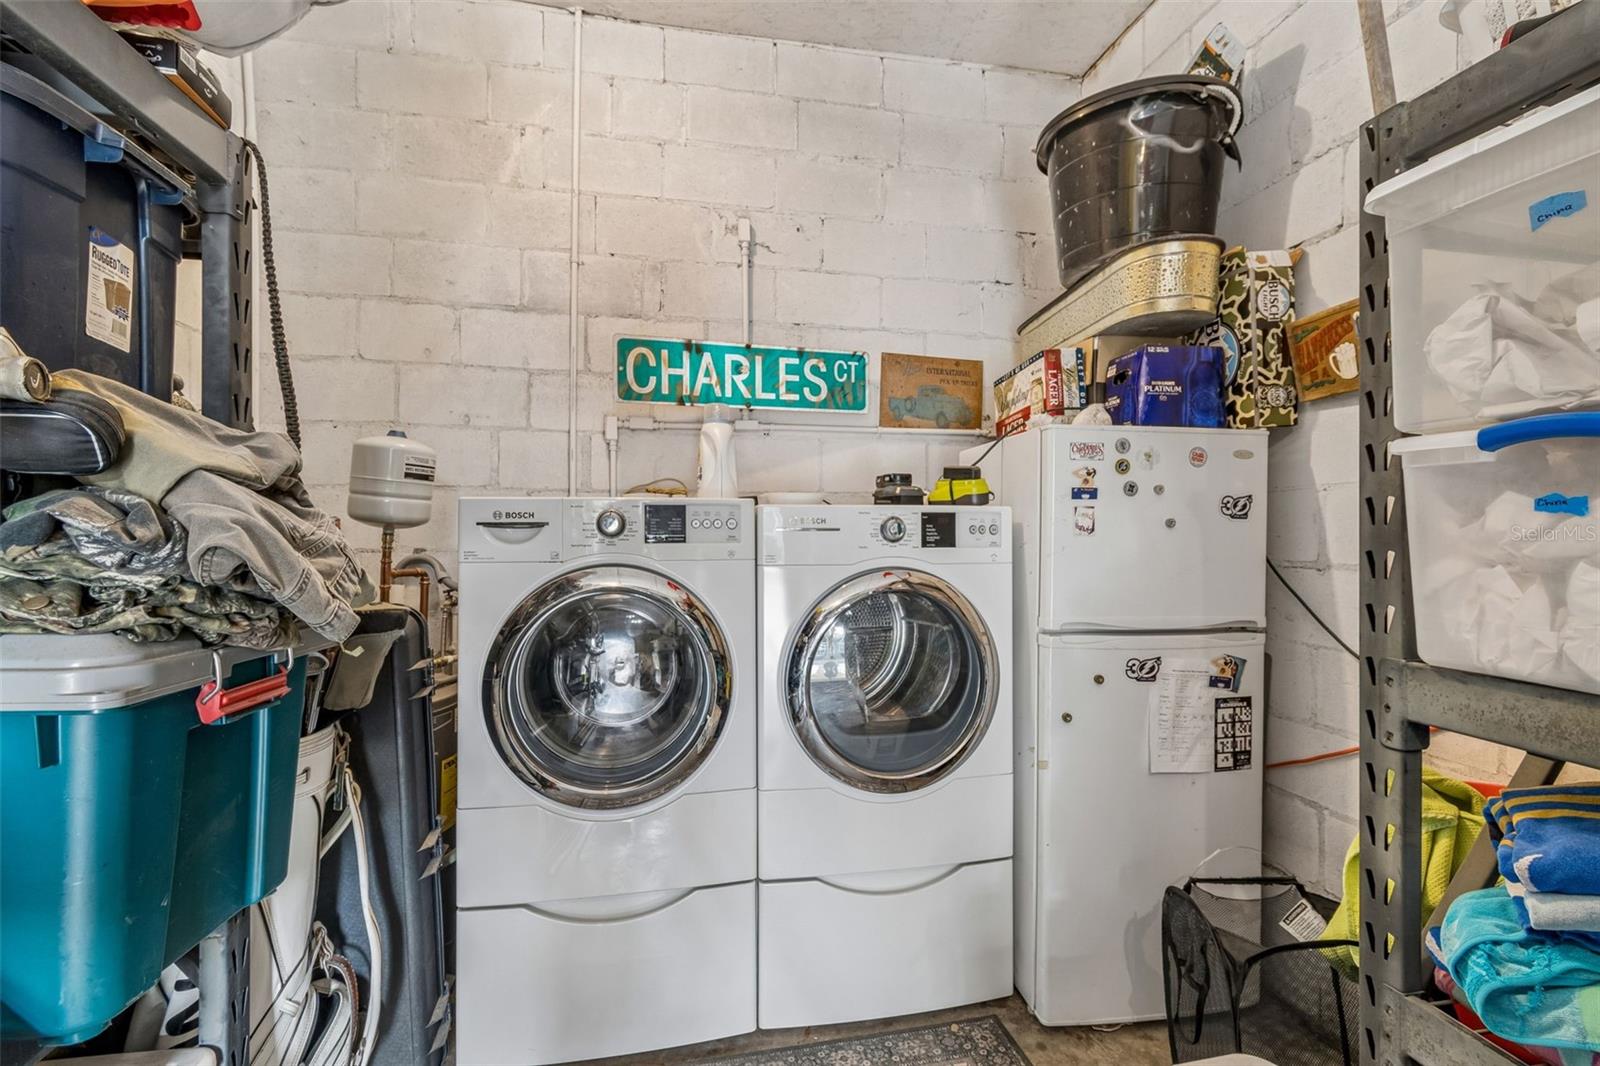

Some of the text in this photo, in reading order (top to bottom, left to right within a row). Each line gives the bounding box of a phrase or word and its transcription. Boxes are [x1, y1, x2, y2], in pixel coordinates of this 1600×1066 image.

[1267, 279, 1280, 321] BUSCH
[626, 346, 859, 402] CHARLES CT
[1048, 369, 1059, 406] LAGER
[1144, 385, 1182, 393] PLATINUM
